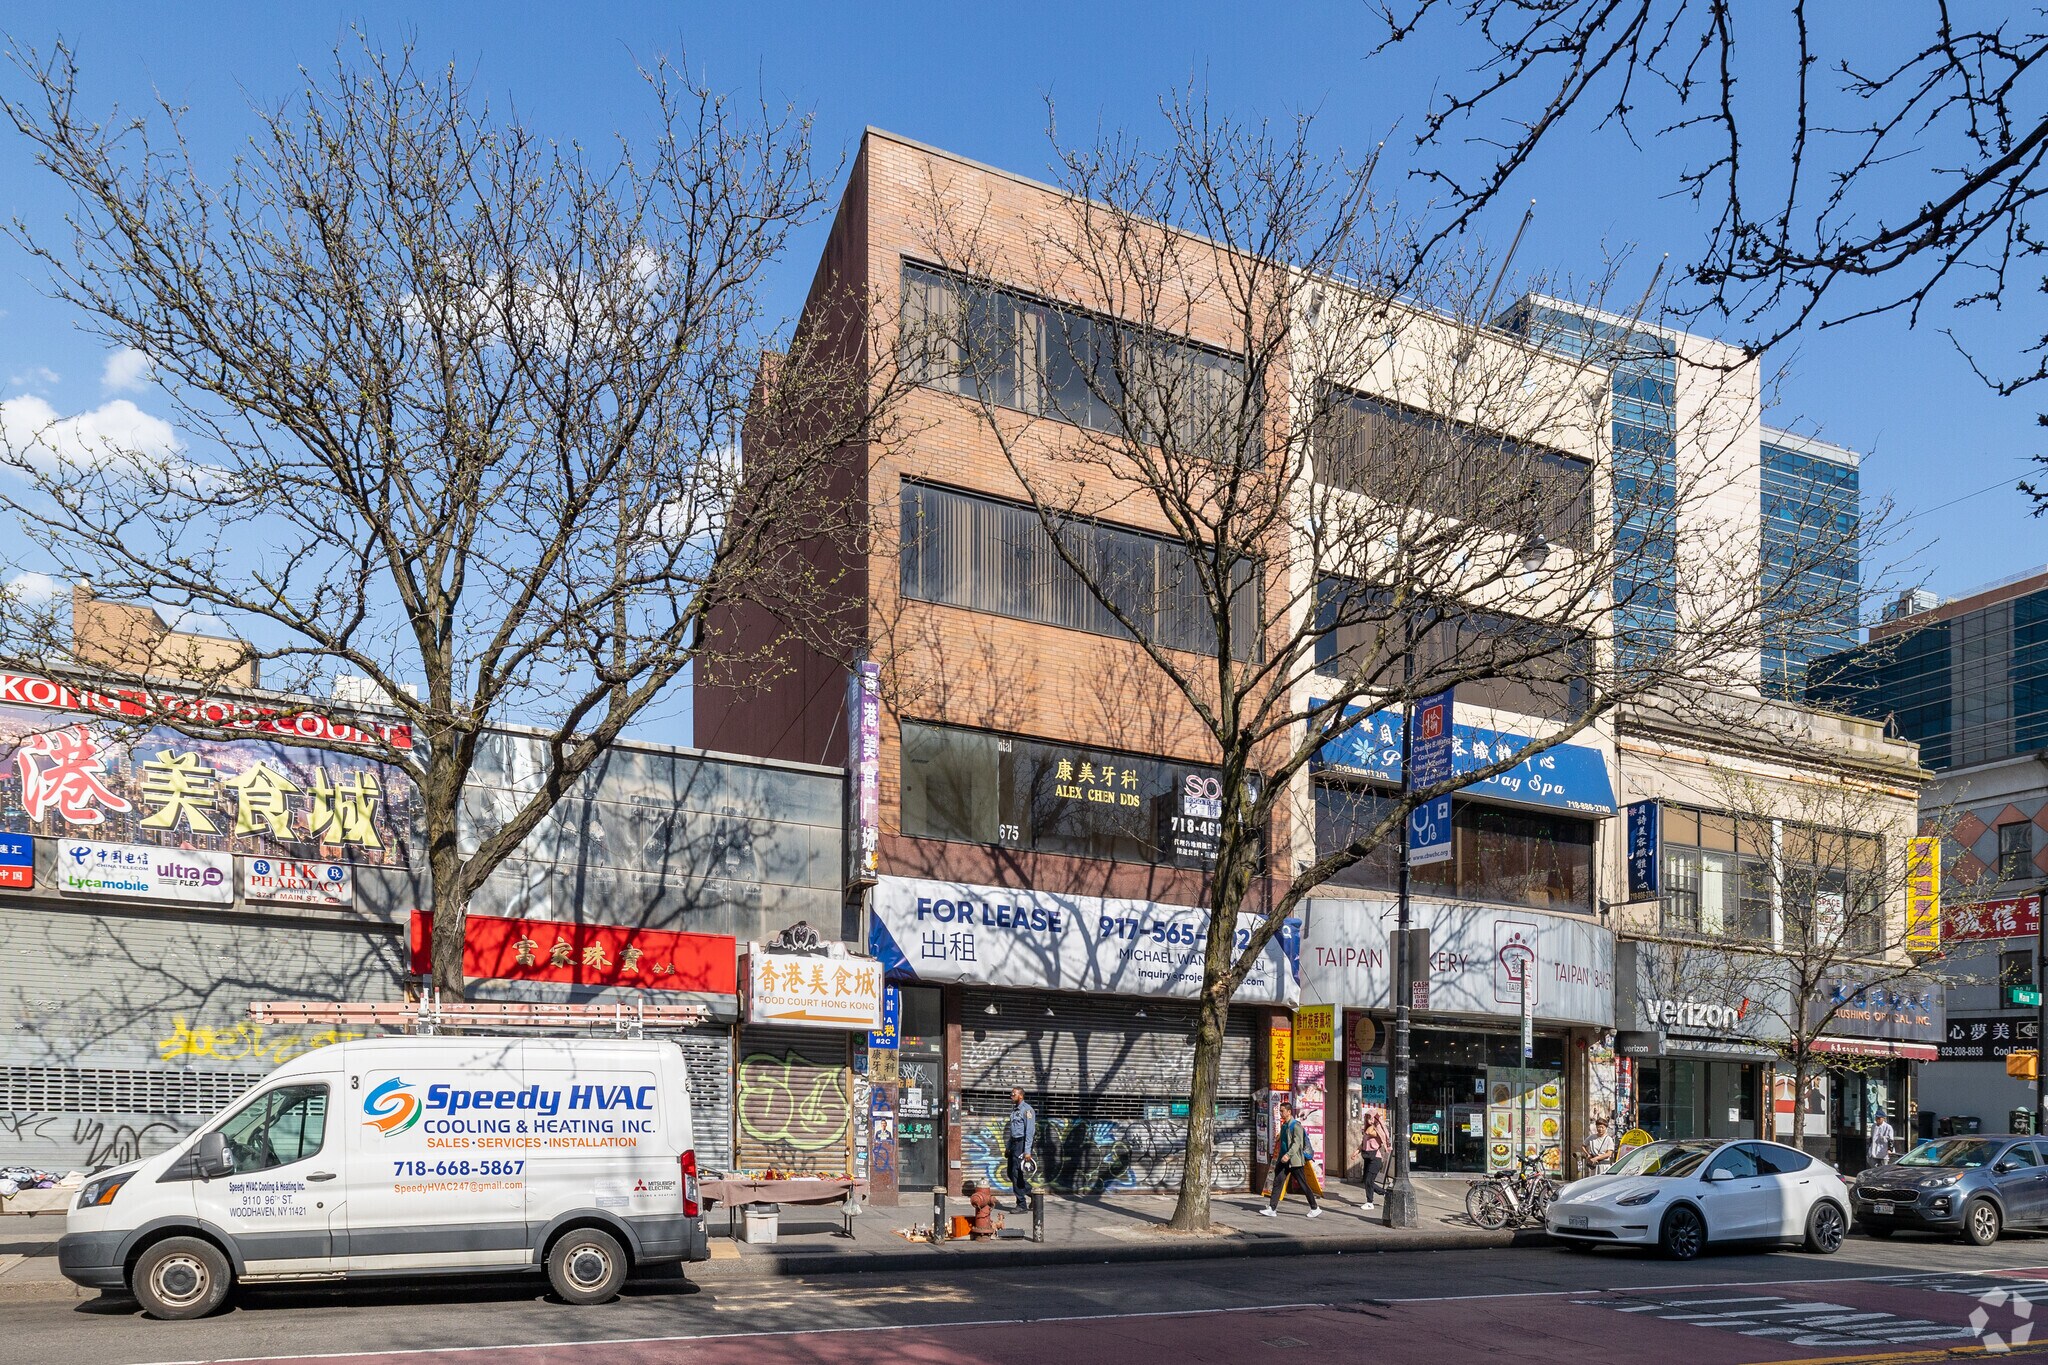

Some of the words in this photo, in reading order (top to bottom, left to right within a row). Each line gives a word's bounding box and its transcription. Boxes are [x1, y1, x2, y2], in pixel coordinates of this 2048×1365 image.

[1055, 758, 1139, 790] 康美牙科
[1528, 774, 1565, 796] Spa
[1055, 784, 1083, 800] ALEX
[1087, 789, 1115, 804] CHEN
[1120, 793, 1140, 807] DDS
[96, 849, 149, 865] 中国电信
[157, 862, 200, 880] ultra
[68, 875, 149, 892] Lycamobile
[251, 875, 346, 893] PHARMACY
[280, 894, 303, 902] MAIN
[917, 898, 974, 924] FOR
[982, 903, 1062, 933] LEASE
[921, 930, 977, 962] 出租
[1119, 949, 1174, 964] MICHAEL
[1178, 953, 1206, 966] WAN
[1315, 947, 1383, 969] TAIPAN
[1429, 952, 1469, 974] KERY
[757, 959, 877, 999] 香港美食城
[1555, 962, 1589, 987] TAIPAN
[758, 996, 785, 1005] FOOD
[787, 998, 819, 1007] COURT
[821, 1000, 847, 1008] HONG
[850, 1002, 875, 1011] KONG
[1645, 995, 1739, 1030] verizon
[1624, 1044, 1649, 1053] verizon
[351, 1076, 359, 1089] 3
[425, 1083, 562, 1116] Speedy
[568, 1084, 656, 1110] HVAC
[423, 1119, 511, 1134] COOLING
[516, 1119, 529, 1134] &
[534, 1119, 612, 1133] HEATING
[622, 1120, 656, 1134] INC.
[427, 1137, 470, 1148] SALES
[477, 1137, 541, 1148] SERVICES
[549, 1137, 637, 1148] INSTALLATION
[393, 1160, 525, 1177] 718-668-5867
[229, 1182, 245, 1193] Speedy
[245, 1182, 258, 1192] HVAC
[258, 1182, 275, 1193] Cooling
[280, 1182, 297, 1193] Heating
[394, 1180, 523, 1194] SpeedyHVAC247@gmail.com
[242, 1195, 261, 1205] 9110
[281, 1195, 293, 1204] ST.
[229, 1207, 277, 1217] WOODHAVEN,
[277, 1207, 288, 1216] NY
